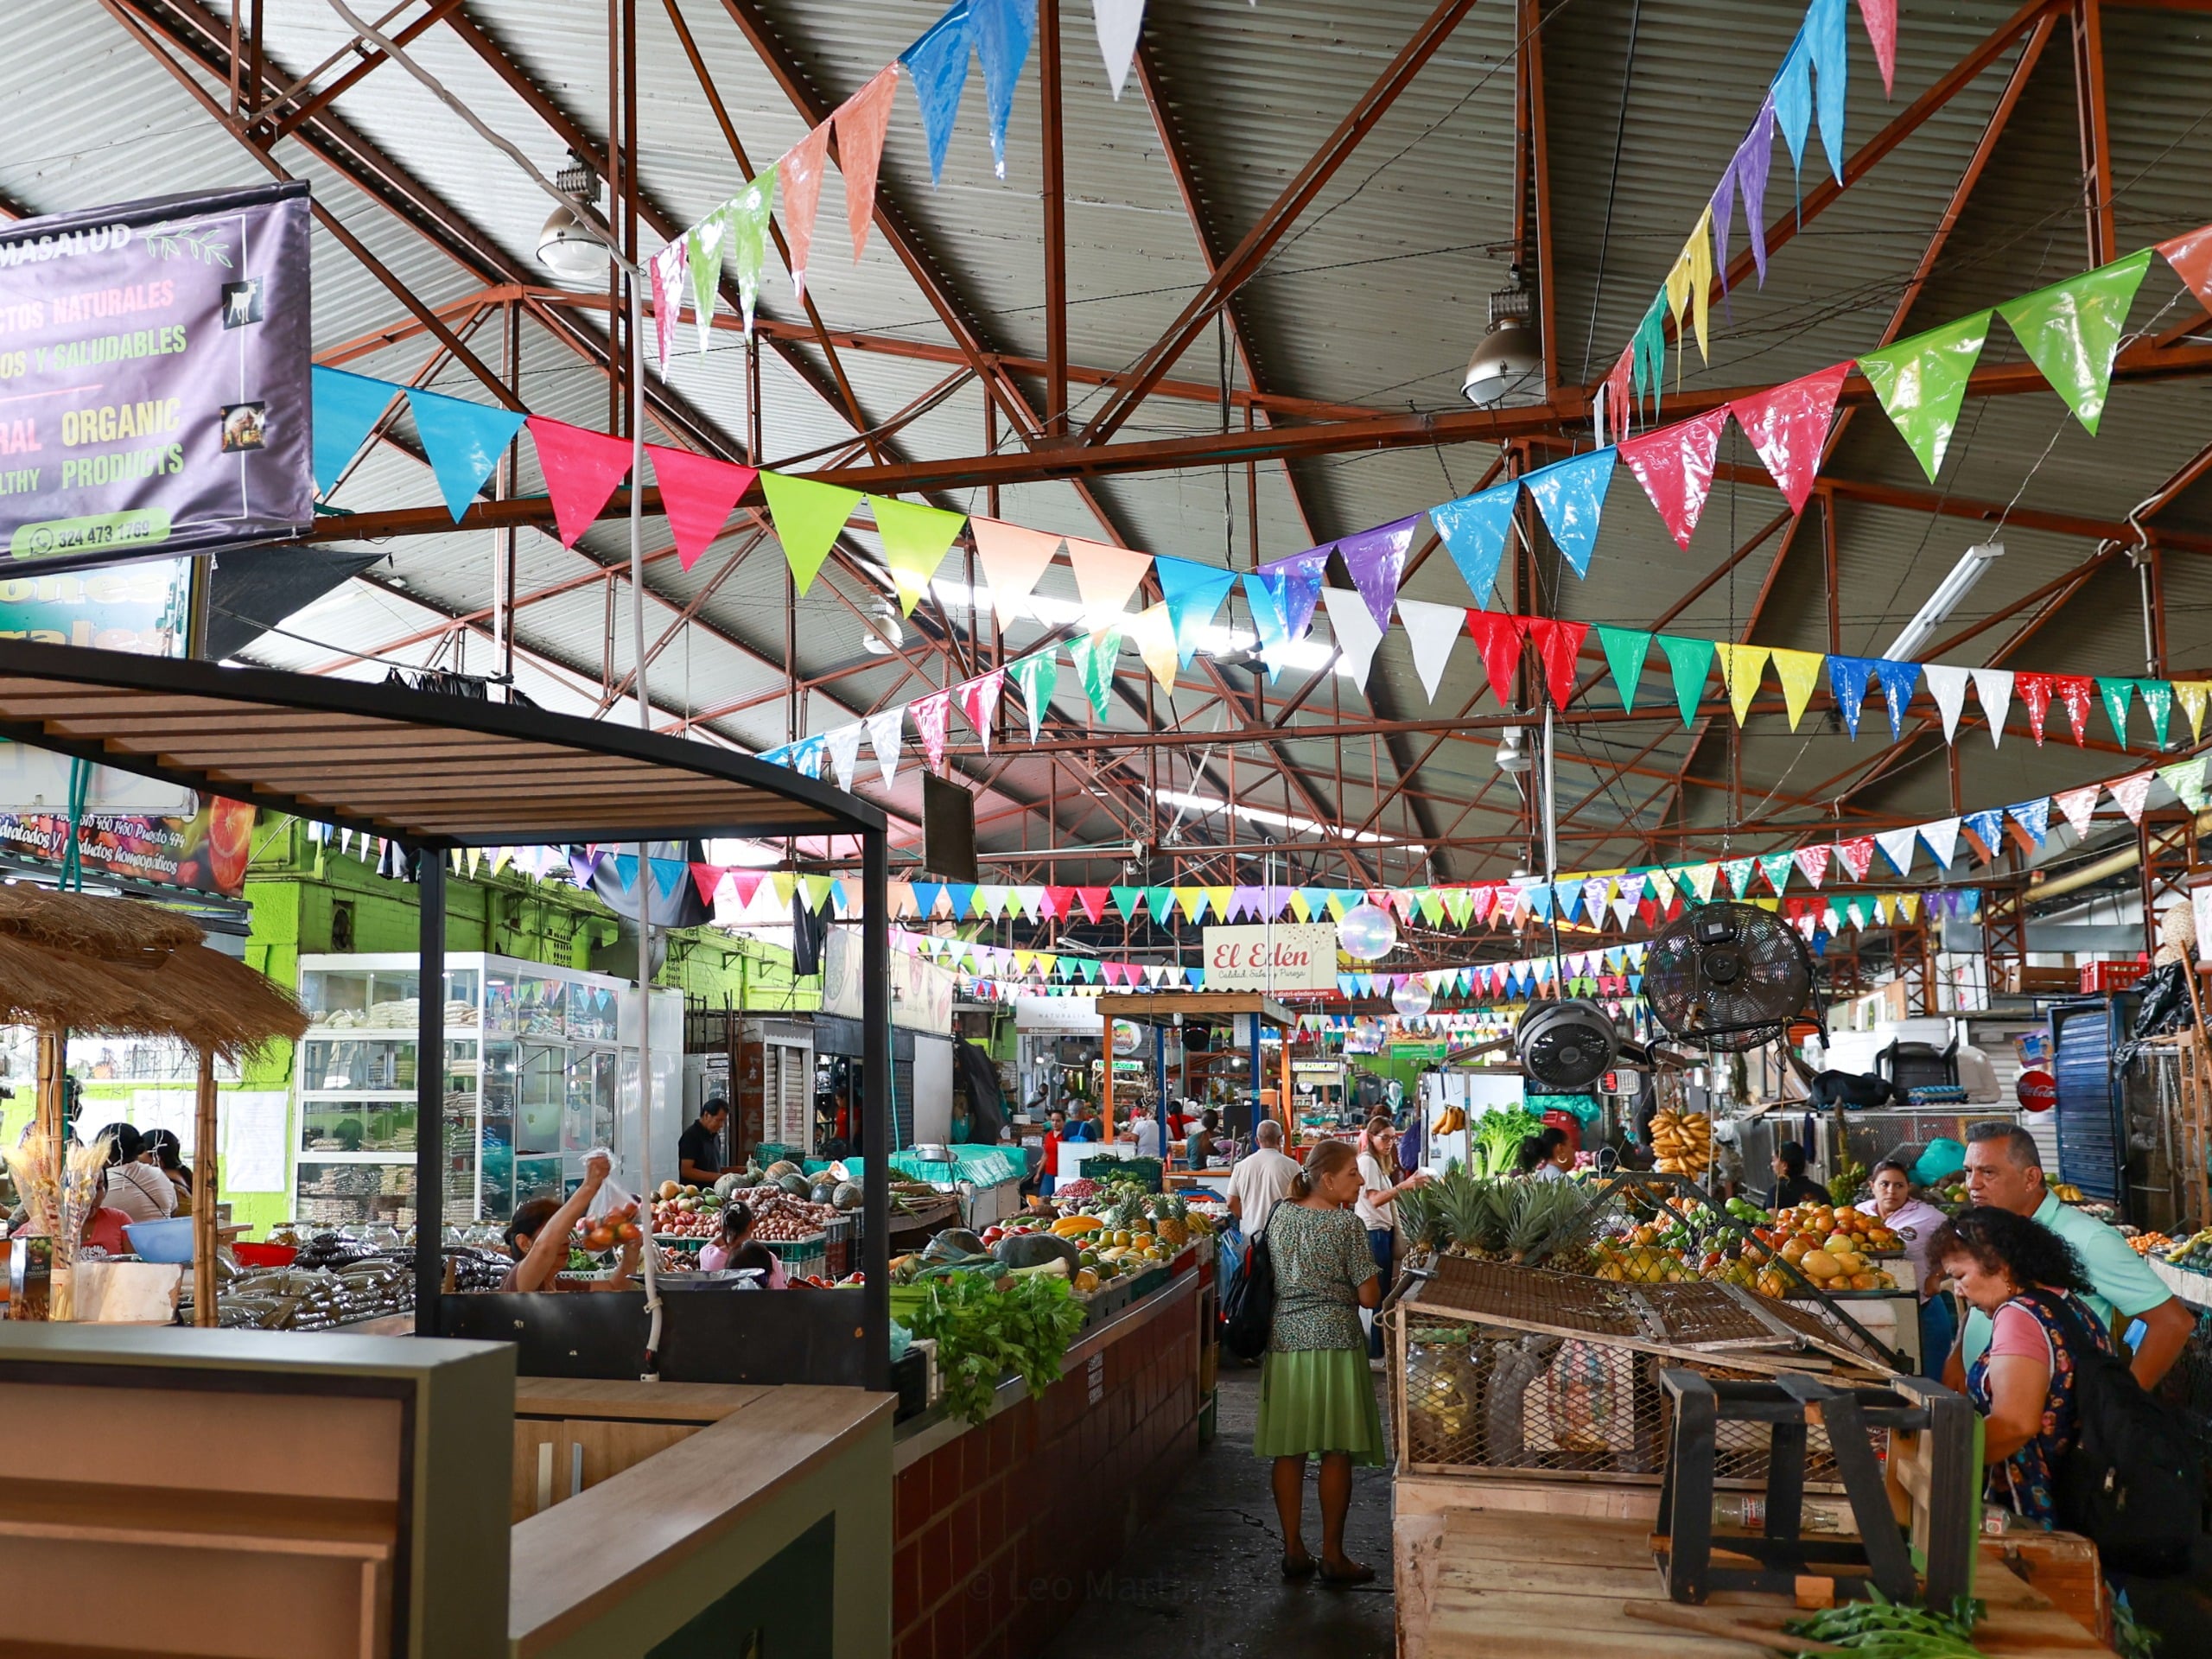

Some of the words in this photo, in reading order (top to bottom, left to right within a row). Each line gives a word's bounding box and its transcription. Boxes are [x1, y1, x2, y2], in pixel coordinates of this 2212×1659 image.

[53, 279, 175, 325] NATURALES
[35, 346, 48, 373] Y
[54, 324, 187, 371] SALUDABLES
[62, 397, 181, 447] ORGANIC
[62, 442, 184, 490] PRODUCTS
[58, 528, 84, 549] 324
[87, 524, 113, 544] 473
[117, 519, 150, 540] 1769
[96, 817, 113, 832] 460
[114, 819, 134, 836] 1450
[135, 823, 168, 844] Puesto
[168, 831, 186, 849] 474
[114, 845, 178, 875] homeopáticos
[1213, 943, 1242, 969] El
[1249, 942, 1311, 968] Edén
[1280, 969, 1306, 979] Pureza
